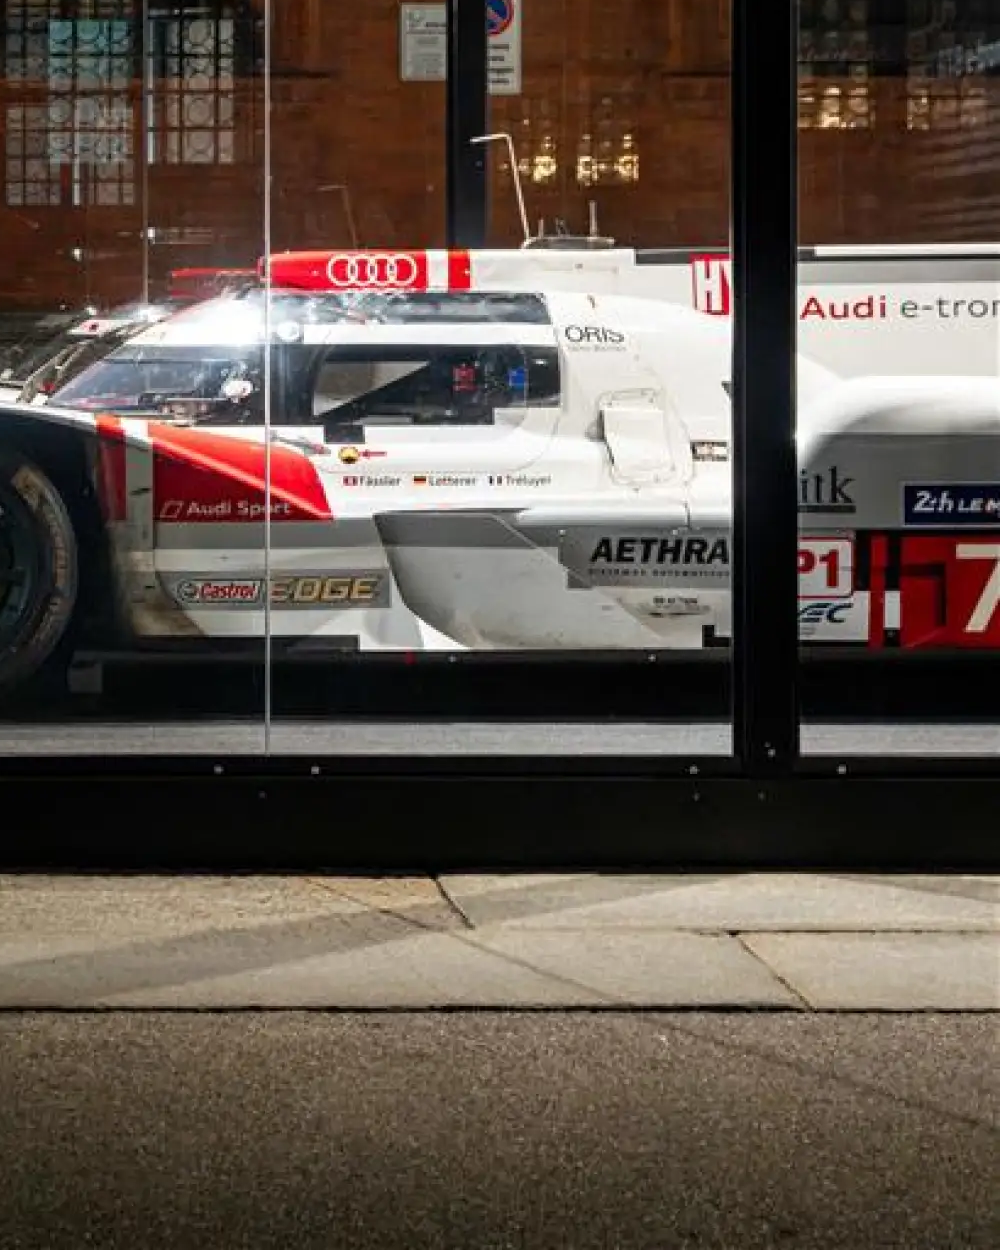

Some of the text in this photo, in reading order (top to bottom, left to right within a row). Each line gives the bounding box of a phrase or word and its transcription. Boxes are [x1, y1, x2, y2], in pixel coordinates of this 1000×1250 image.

[800, 295, 886, 320] Audi
[564, 326, 625, 343] ORIS
[186, 501, 291, 519] Audi Sport
[588, 536, 730, 565] AETHRA
[200, 581, 260, 600] Castrol
[268, 578, 379, 600] EDGE
